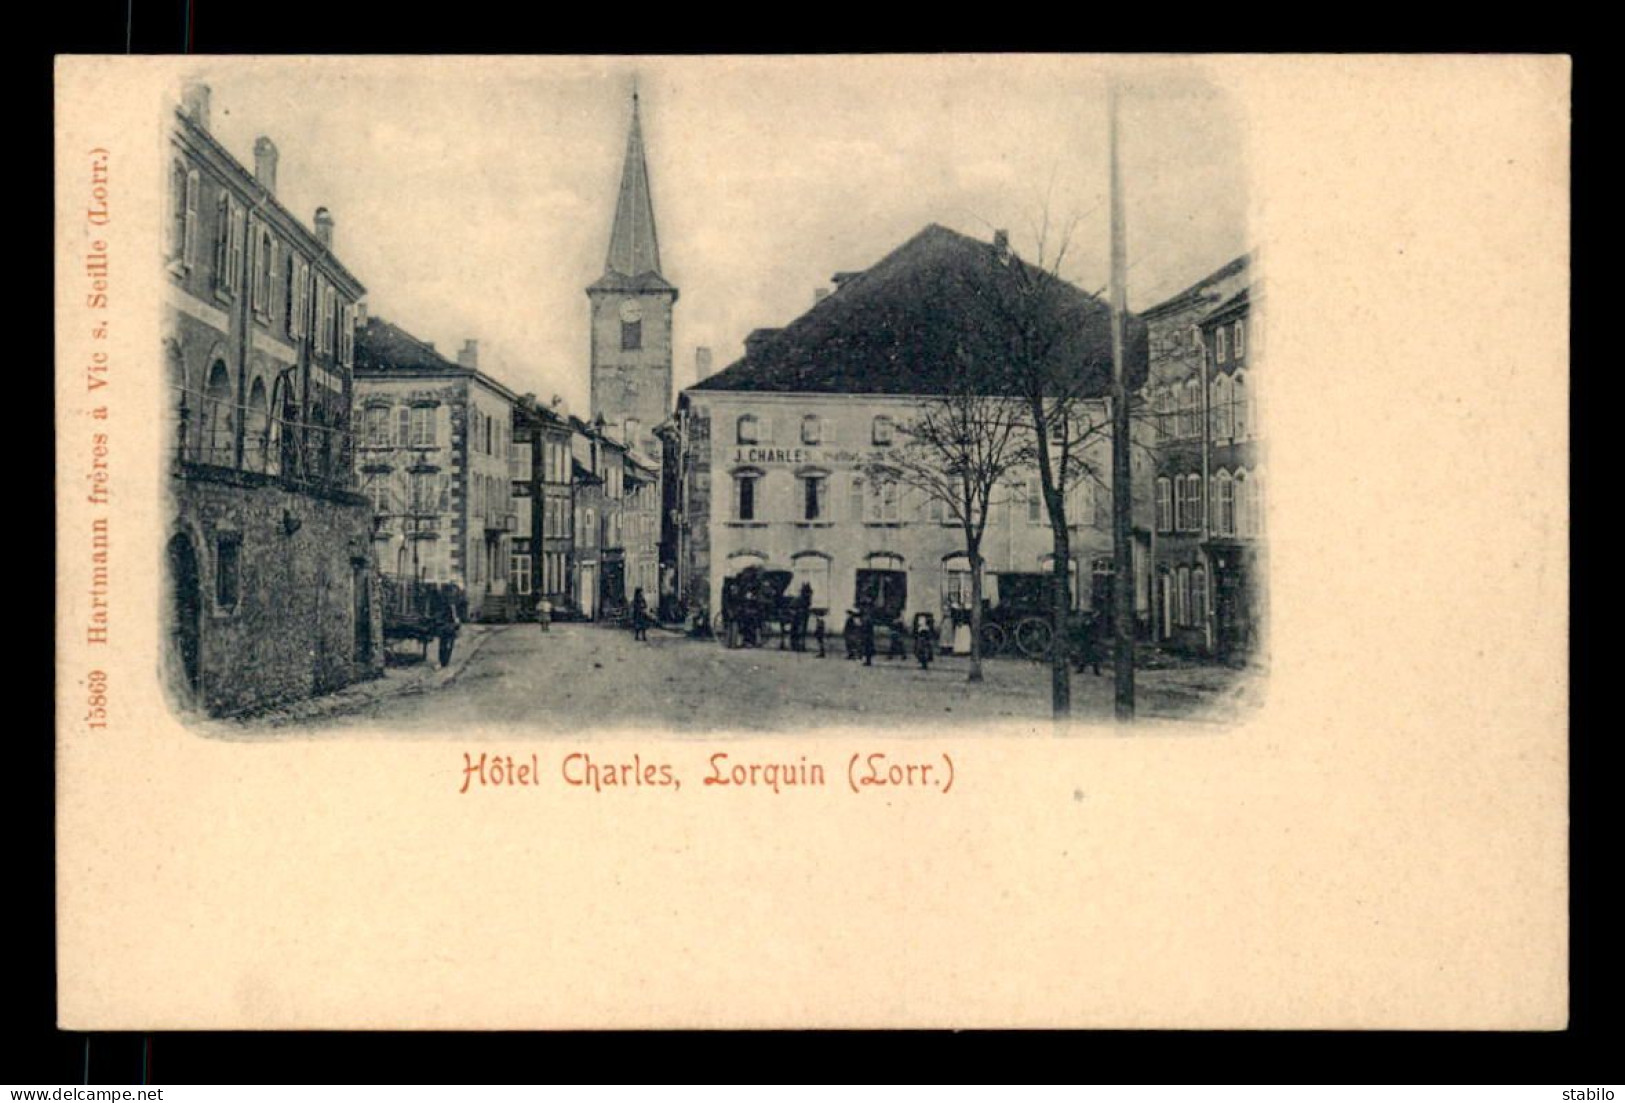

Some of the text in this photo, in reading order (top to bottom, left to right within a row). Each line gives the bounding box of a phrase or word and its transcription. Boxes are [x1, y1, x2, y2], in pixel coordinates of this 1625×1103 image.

[86, 146, 109, 731] 15869 Hartmann frères à Vic s. Seille (Lorr.)
[460, 751, 956, 796] Hôtel Charles, Lorquin (Lorr.)
